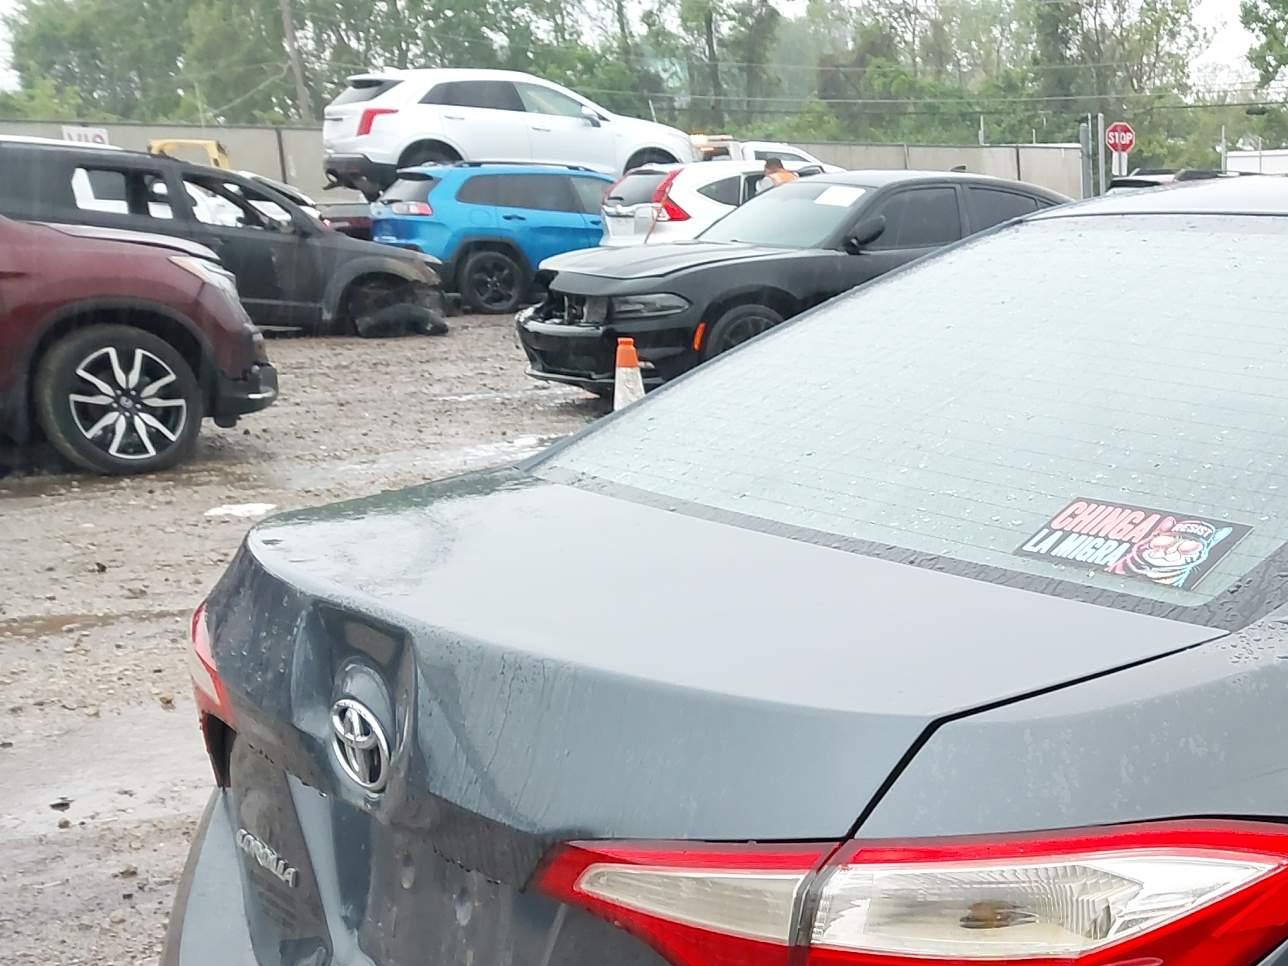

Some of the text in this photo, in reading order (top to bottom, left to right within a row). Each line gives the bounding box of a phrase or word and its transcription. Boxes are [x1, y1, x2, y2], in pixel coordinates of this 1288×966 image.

[1108, 131, 1133, 144] STOP
[1050, 502, 1161, 543] CHINGA
[1171, 523, 1213, 537] RESIST
[1022, 528, 1131, 566] LA MIGRA
[236, 828, 297, 888] COROLLA
